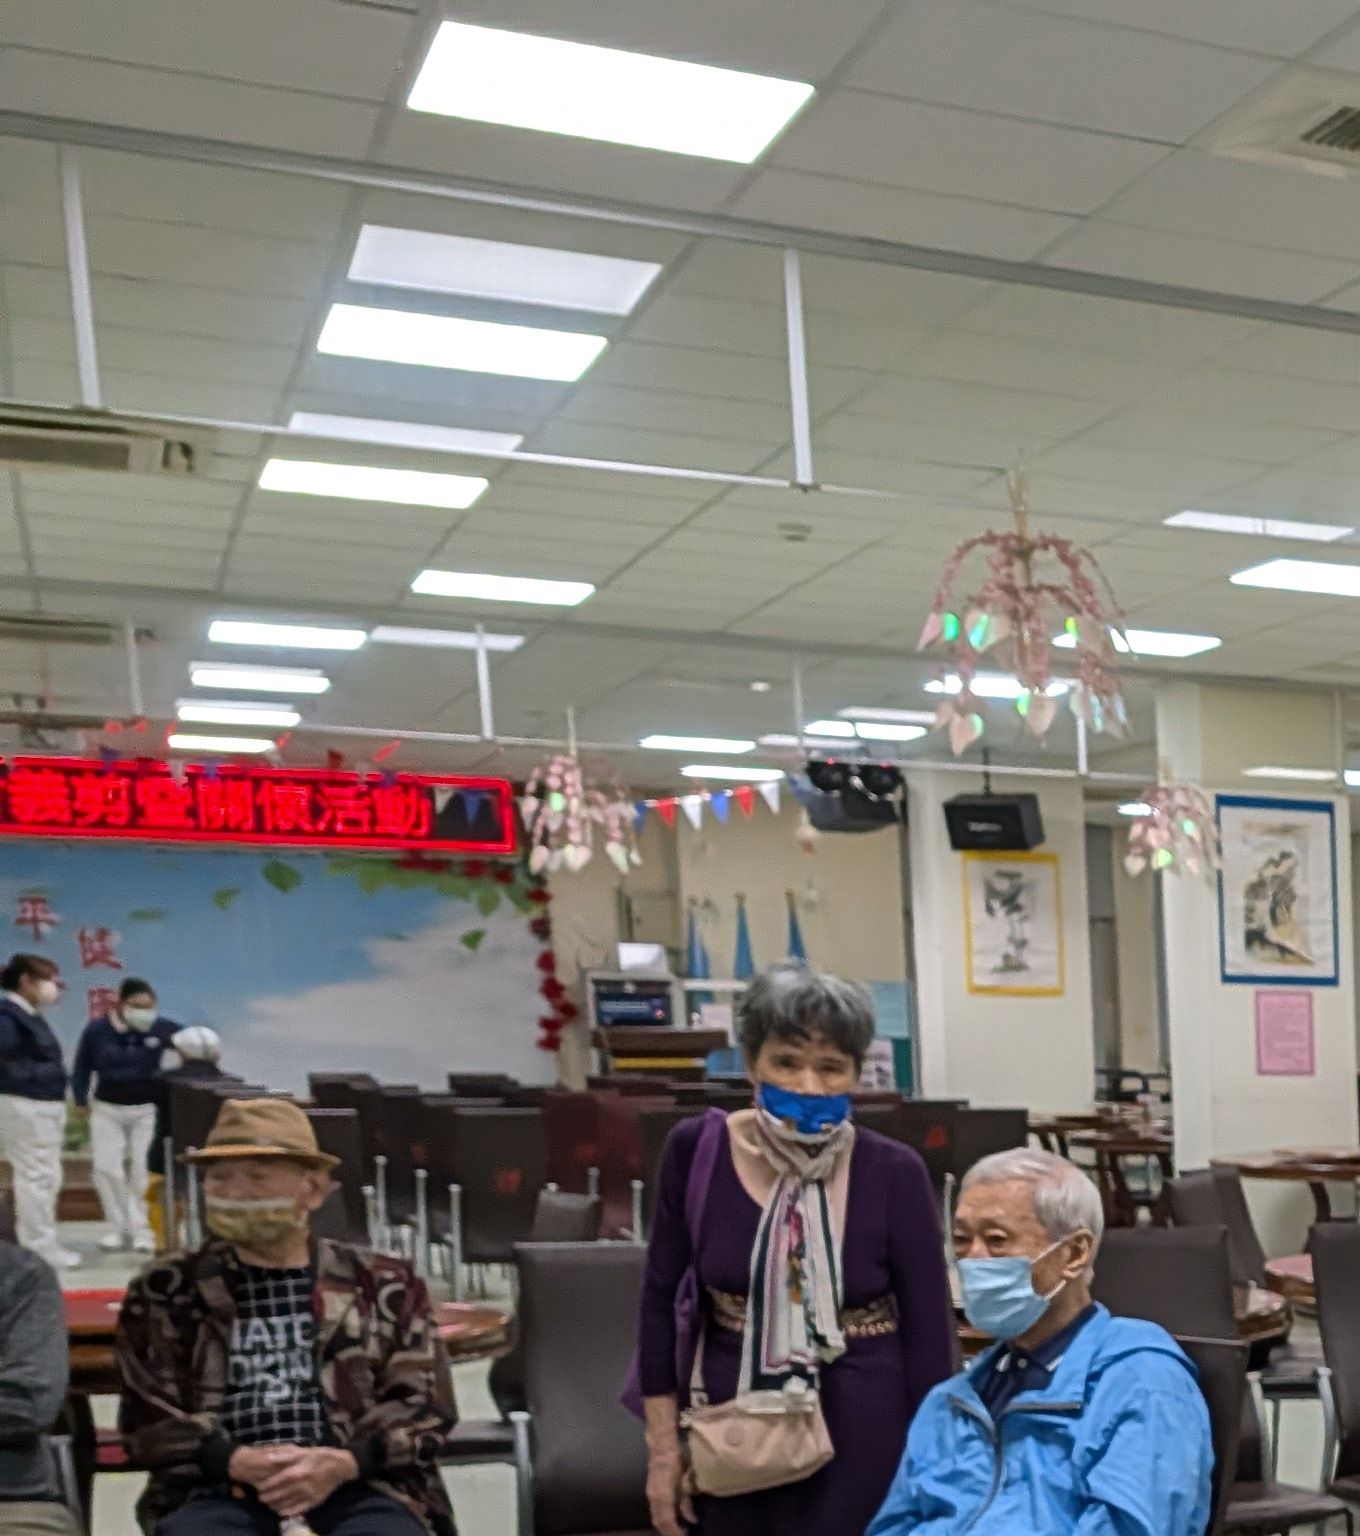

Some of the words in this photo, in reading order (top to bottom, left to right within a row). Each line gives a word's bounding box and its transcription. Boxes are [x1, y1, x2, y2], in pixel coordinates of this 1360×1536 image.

[0, 768, 431, 836] 義剪暨關懷活動
